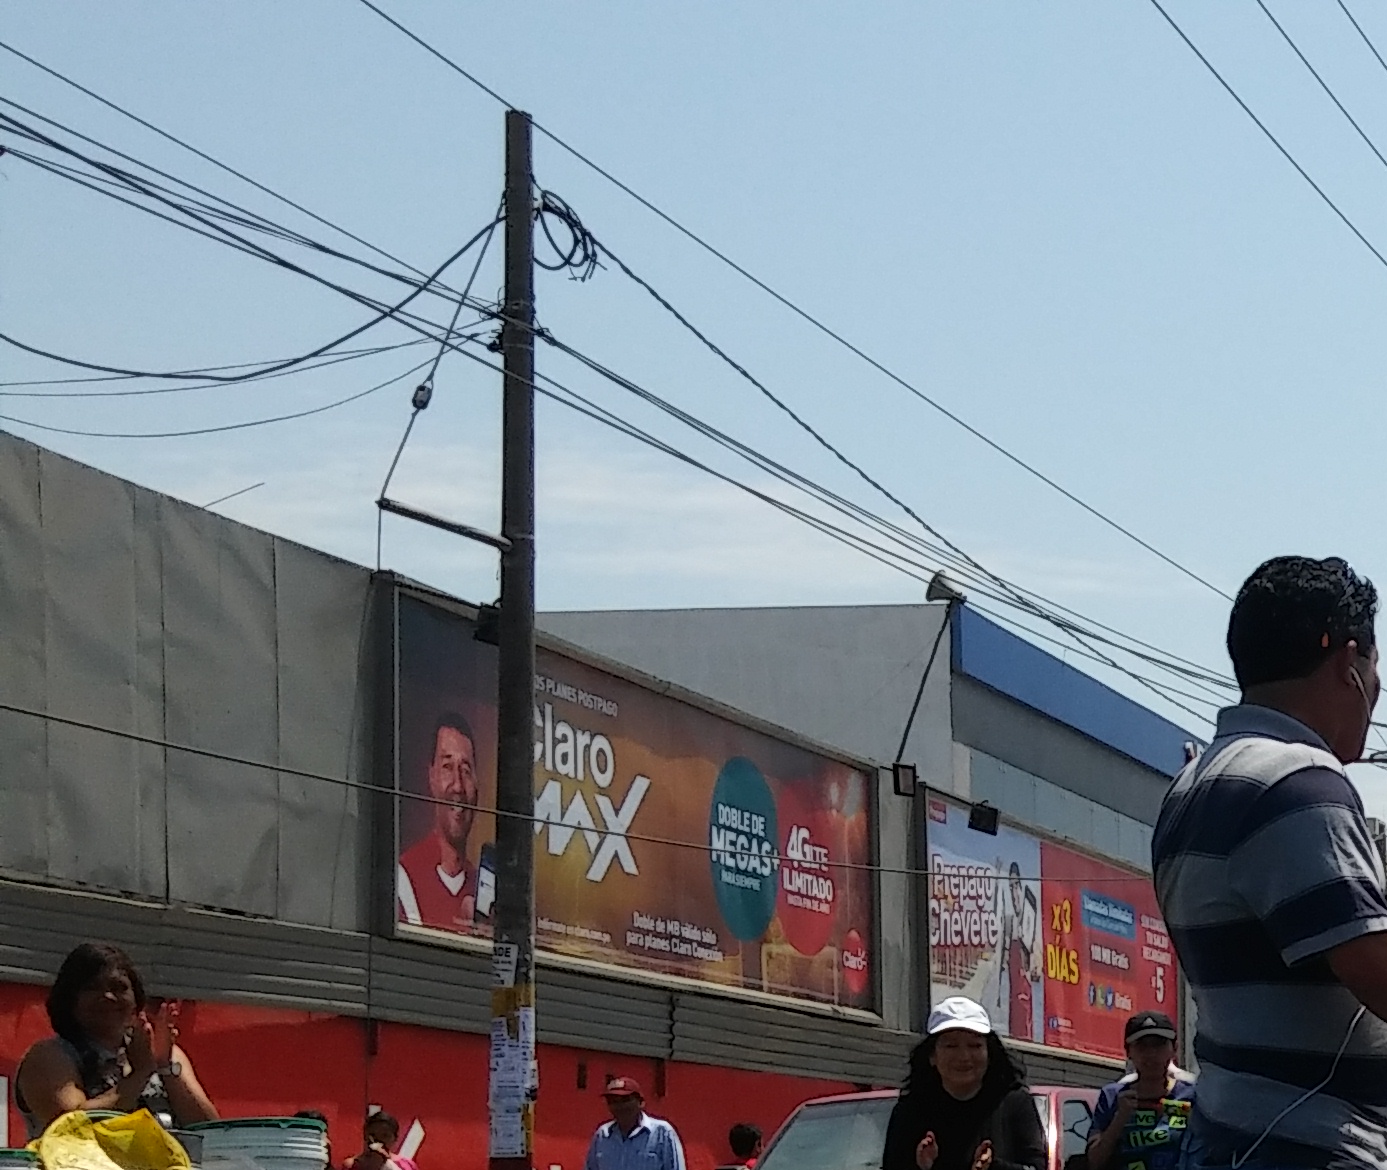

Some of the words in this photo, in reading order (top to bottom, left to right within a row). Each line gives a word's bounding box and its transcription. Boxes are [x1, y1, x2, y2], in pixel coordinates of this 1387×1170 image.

[545, 677, 577, 704] PLANES
[578, 690, 618, 718] POSTPAGO
[717, 803, 750, 833] DOBLE
[751, 814, 766, 838] DE
[783, 867, 833, 902] ILIMITADO
[932, 854, 993, 908] Prepago
[632, 910, 655, 931] Doble
[656, 917, 666, 933] de
[667, 920, 680, 936] MB
[931, 900, 998, 947] Chévere
[626, 930, 644, 946] para
[645, 933, 670, 951] planes
[671, 939, 692, 956] Claro
[1047, 934, 1079, 985] DÍAS
